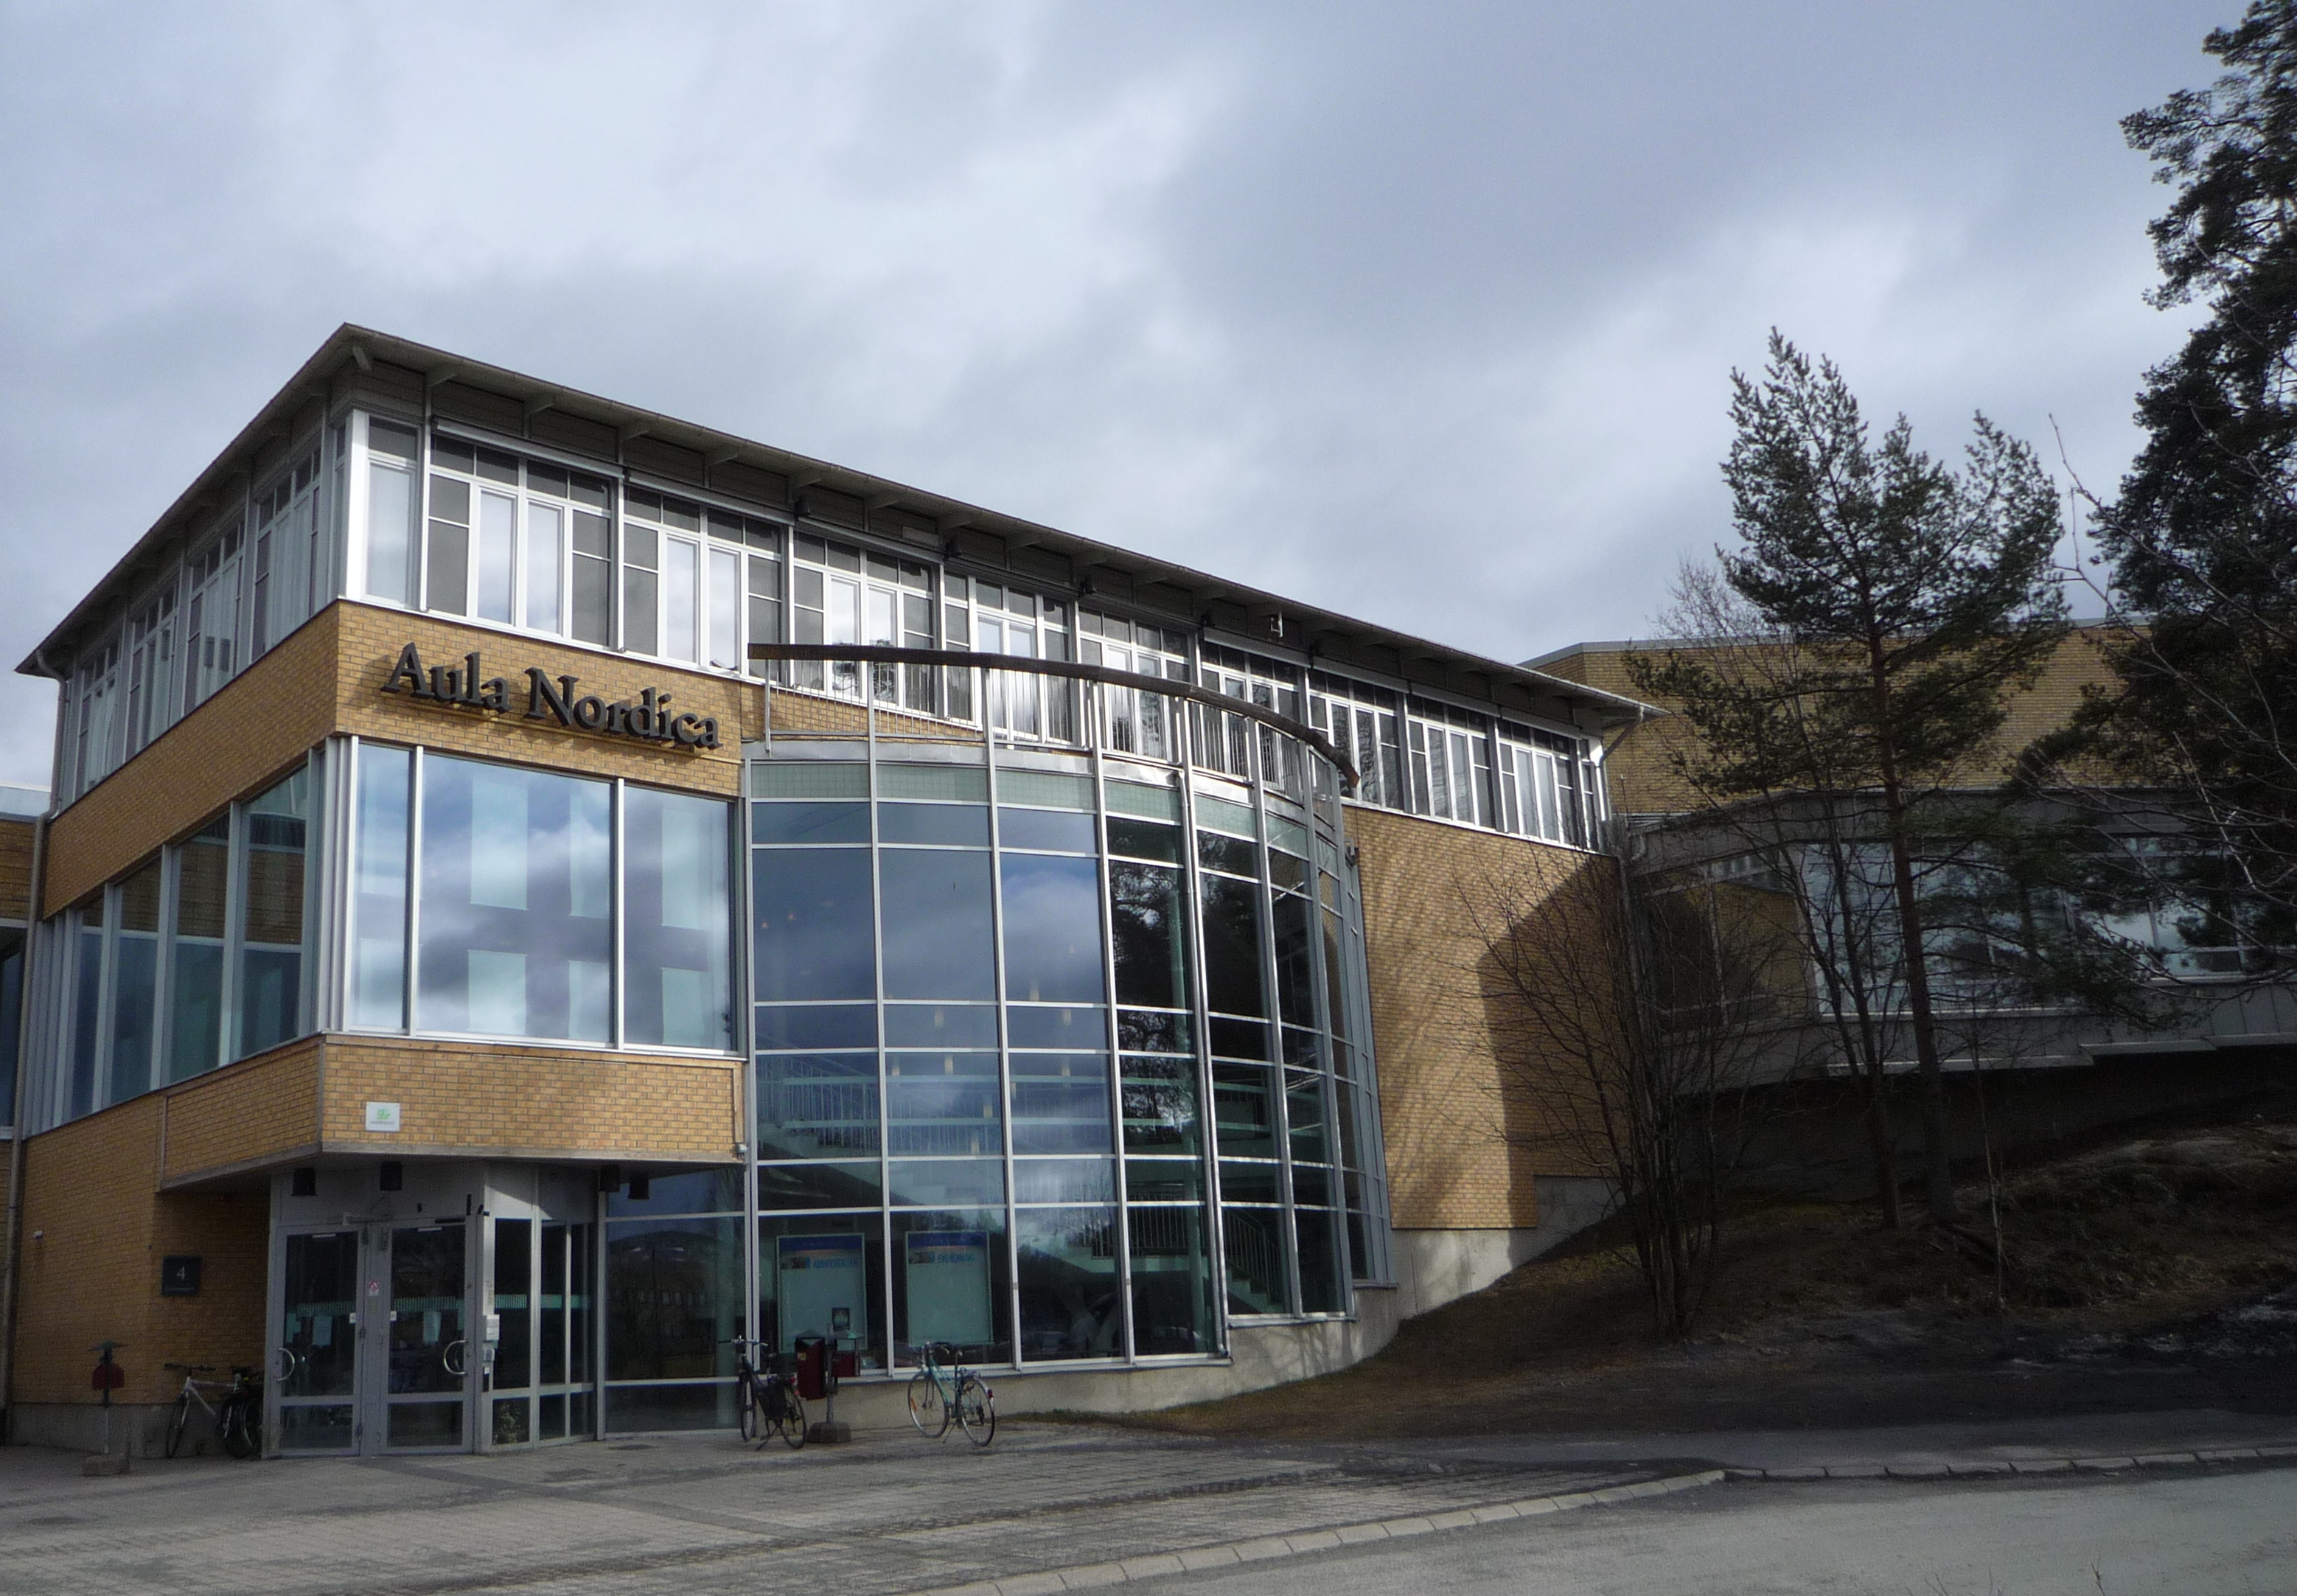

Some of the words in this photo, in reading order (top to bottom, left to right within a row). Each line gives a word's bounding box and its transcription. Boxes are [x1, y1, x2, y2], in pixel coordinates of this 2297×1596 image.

[380, 641, 512, 714] Aula
[523, 667, 724, 750] Nordica
[175, 1266, 187, 1280] 4
